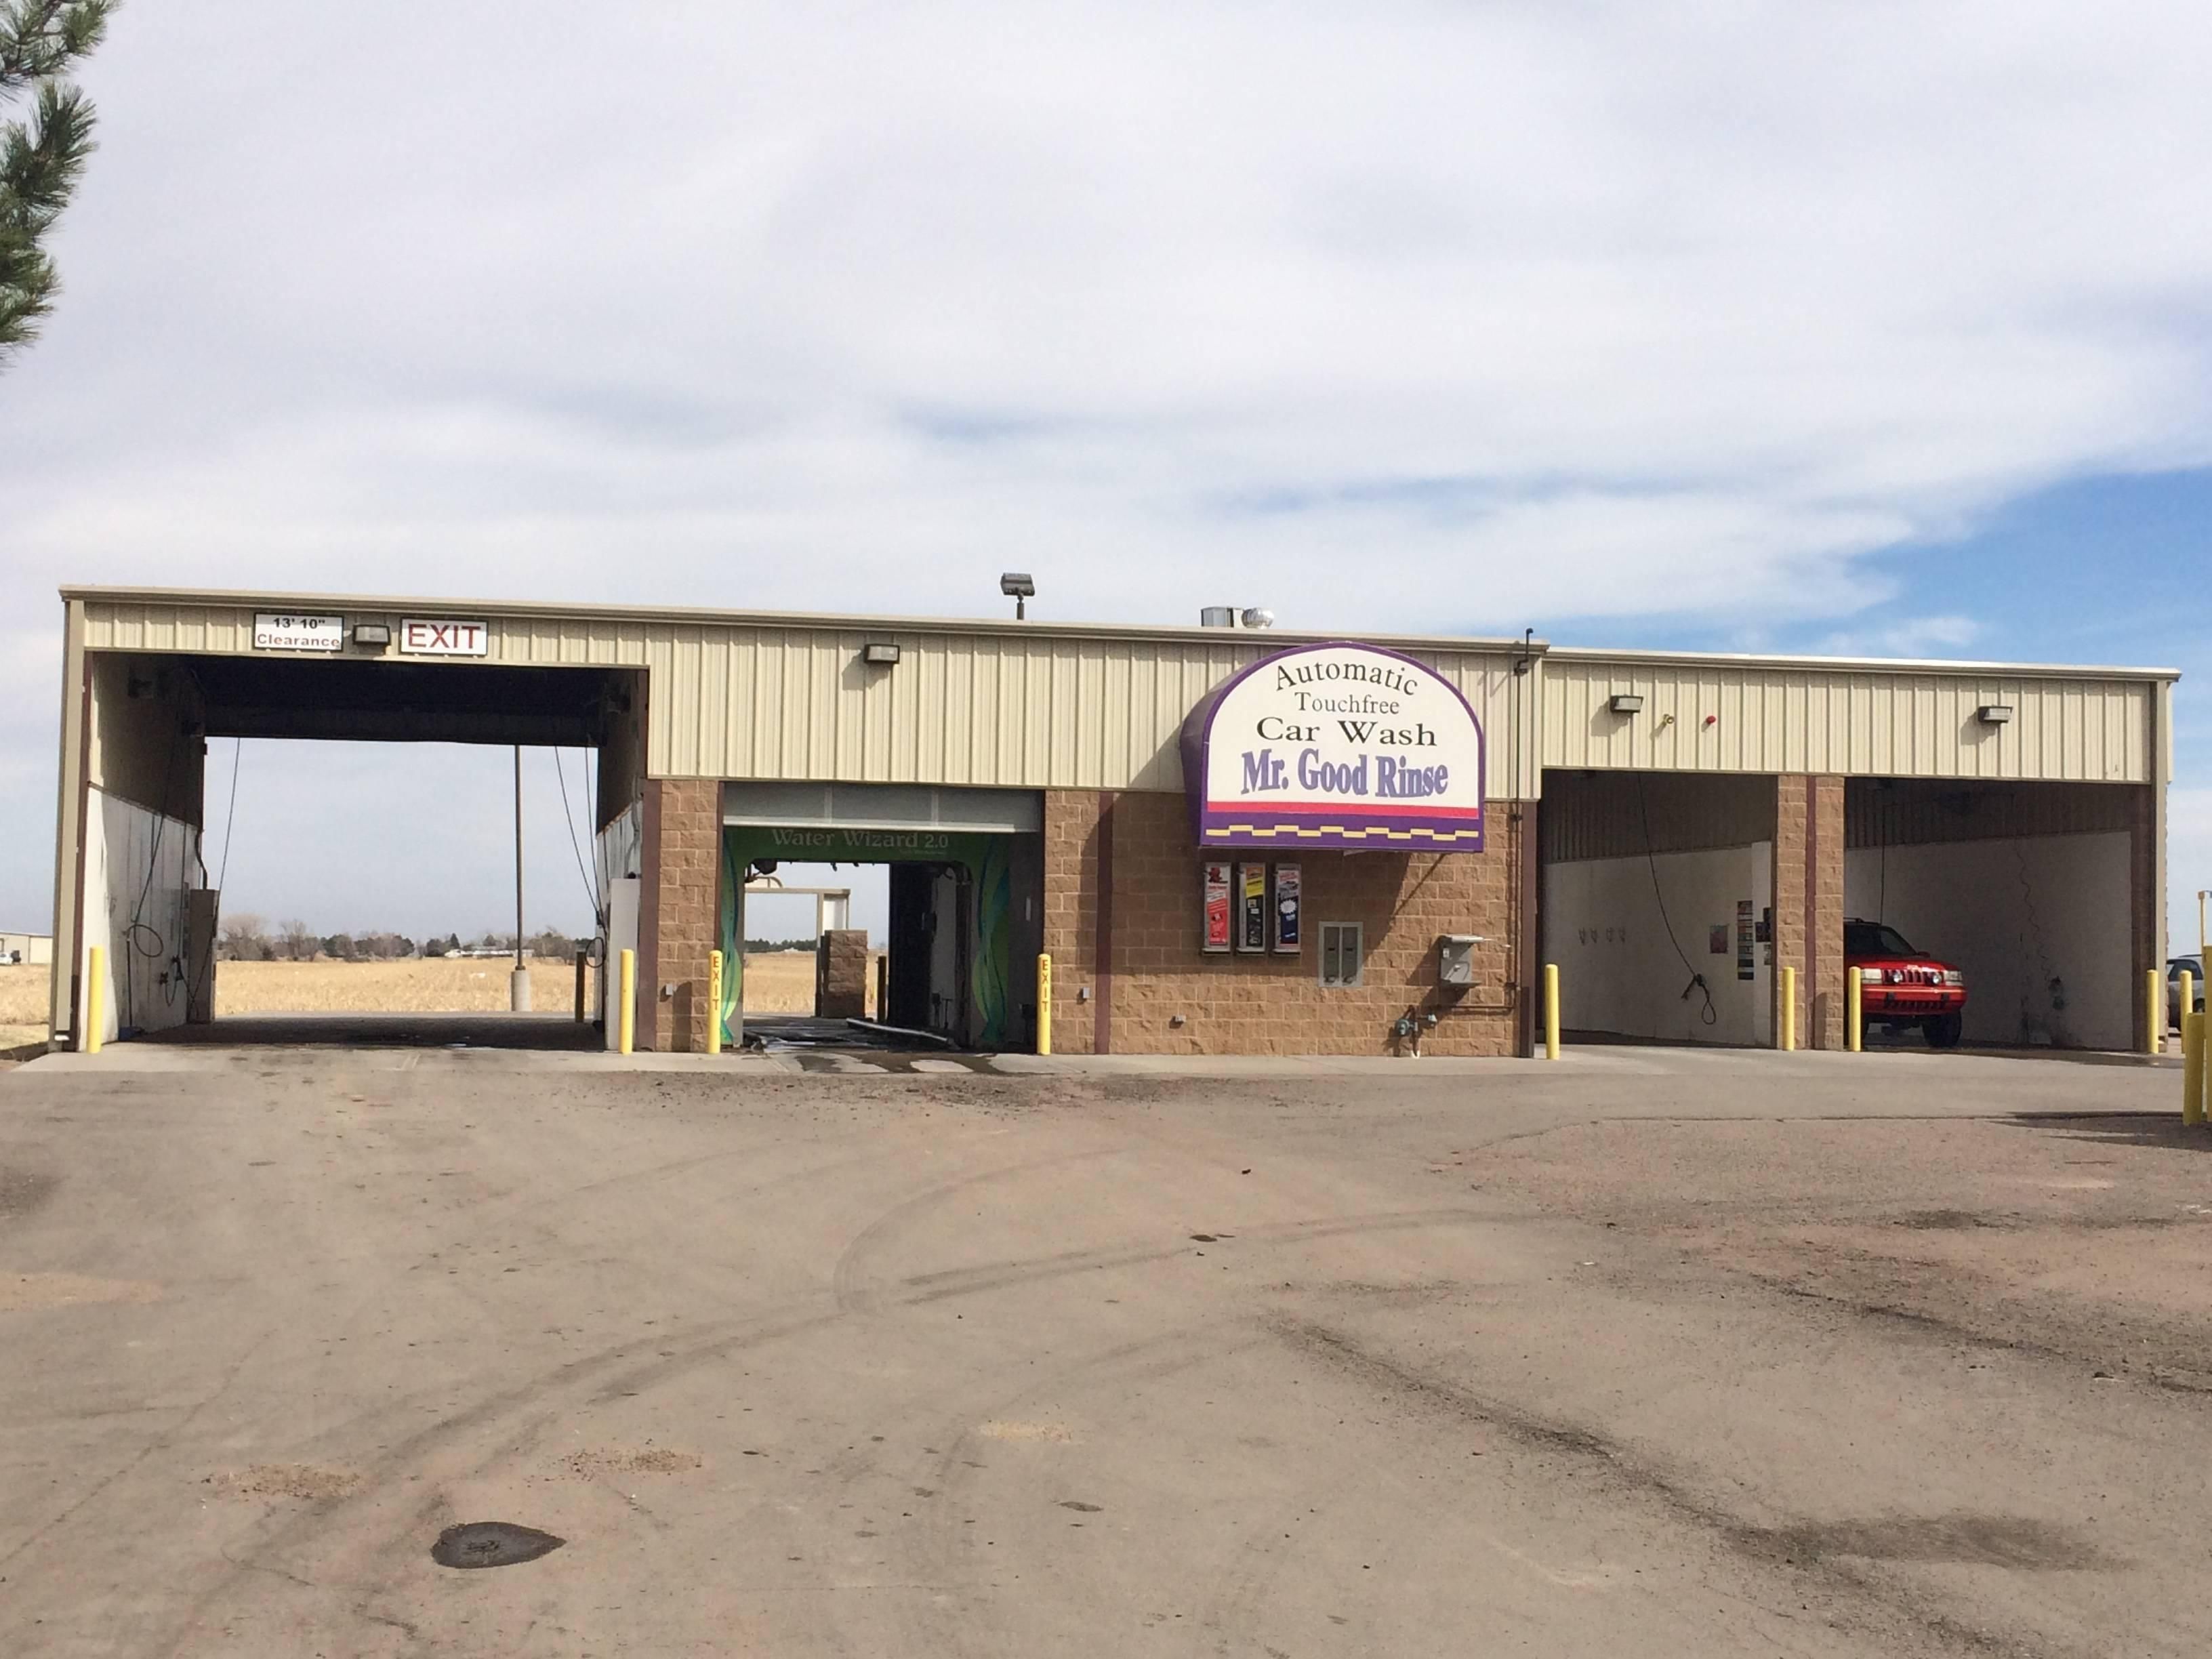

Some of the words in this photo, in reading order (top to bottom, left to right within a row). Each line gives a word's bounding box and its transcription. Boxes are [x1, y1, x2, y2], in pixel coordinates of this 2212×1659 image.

[257, 634, 340, 647] Clearance
[408, 623, 481, 649] EXIT
[1275, 661, 1418, 696] Automatic
[1294, 691, 1400, 715] Touchfree
[1256, 716, 1320, 742] Car
[1337, 720, 1438, 747] Wash
[1240, 748, 1289, 795] Mr.
[1298, 747, 1369, 796] Good
[1374, 754, 1449, 798] Rinse
[772, 828, 836, 846] Water
[843, 830, 918, 848] Wizard
[924, 834, 949, 848] 2.0
[712, 956, 720, 1011] EXIT
